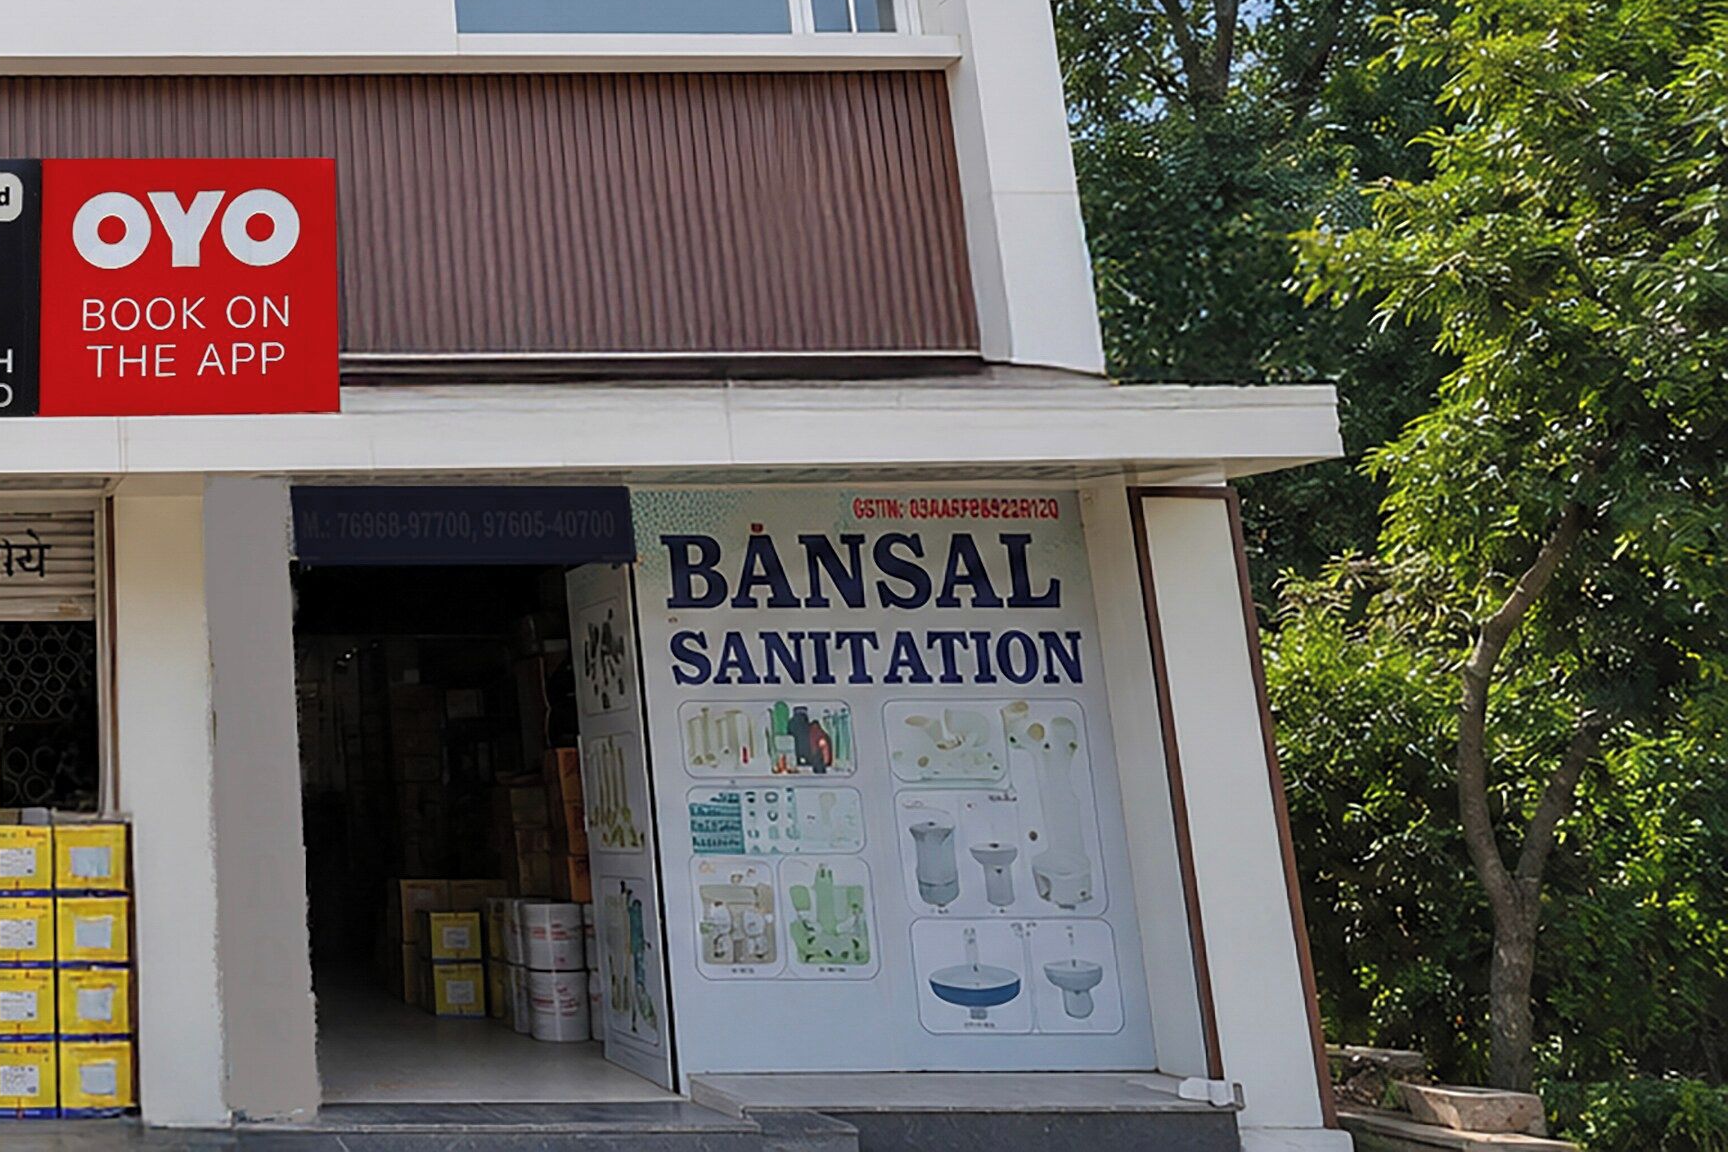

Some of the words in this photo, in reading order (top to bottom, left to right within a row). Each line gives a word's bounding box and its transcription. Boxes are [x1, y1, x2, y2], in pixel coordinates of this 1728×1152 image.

[73, 188, 301, 270] OYO
[81, 297, 206, 332] BOOK
[225, 294, 290, 328] ON
[86, 343, 177, 378] THE
[197, 341, 287, 375] APP
[660, 532, 1061, 609] BANSAL
[669, 629, 1084, 685] SANITATION
